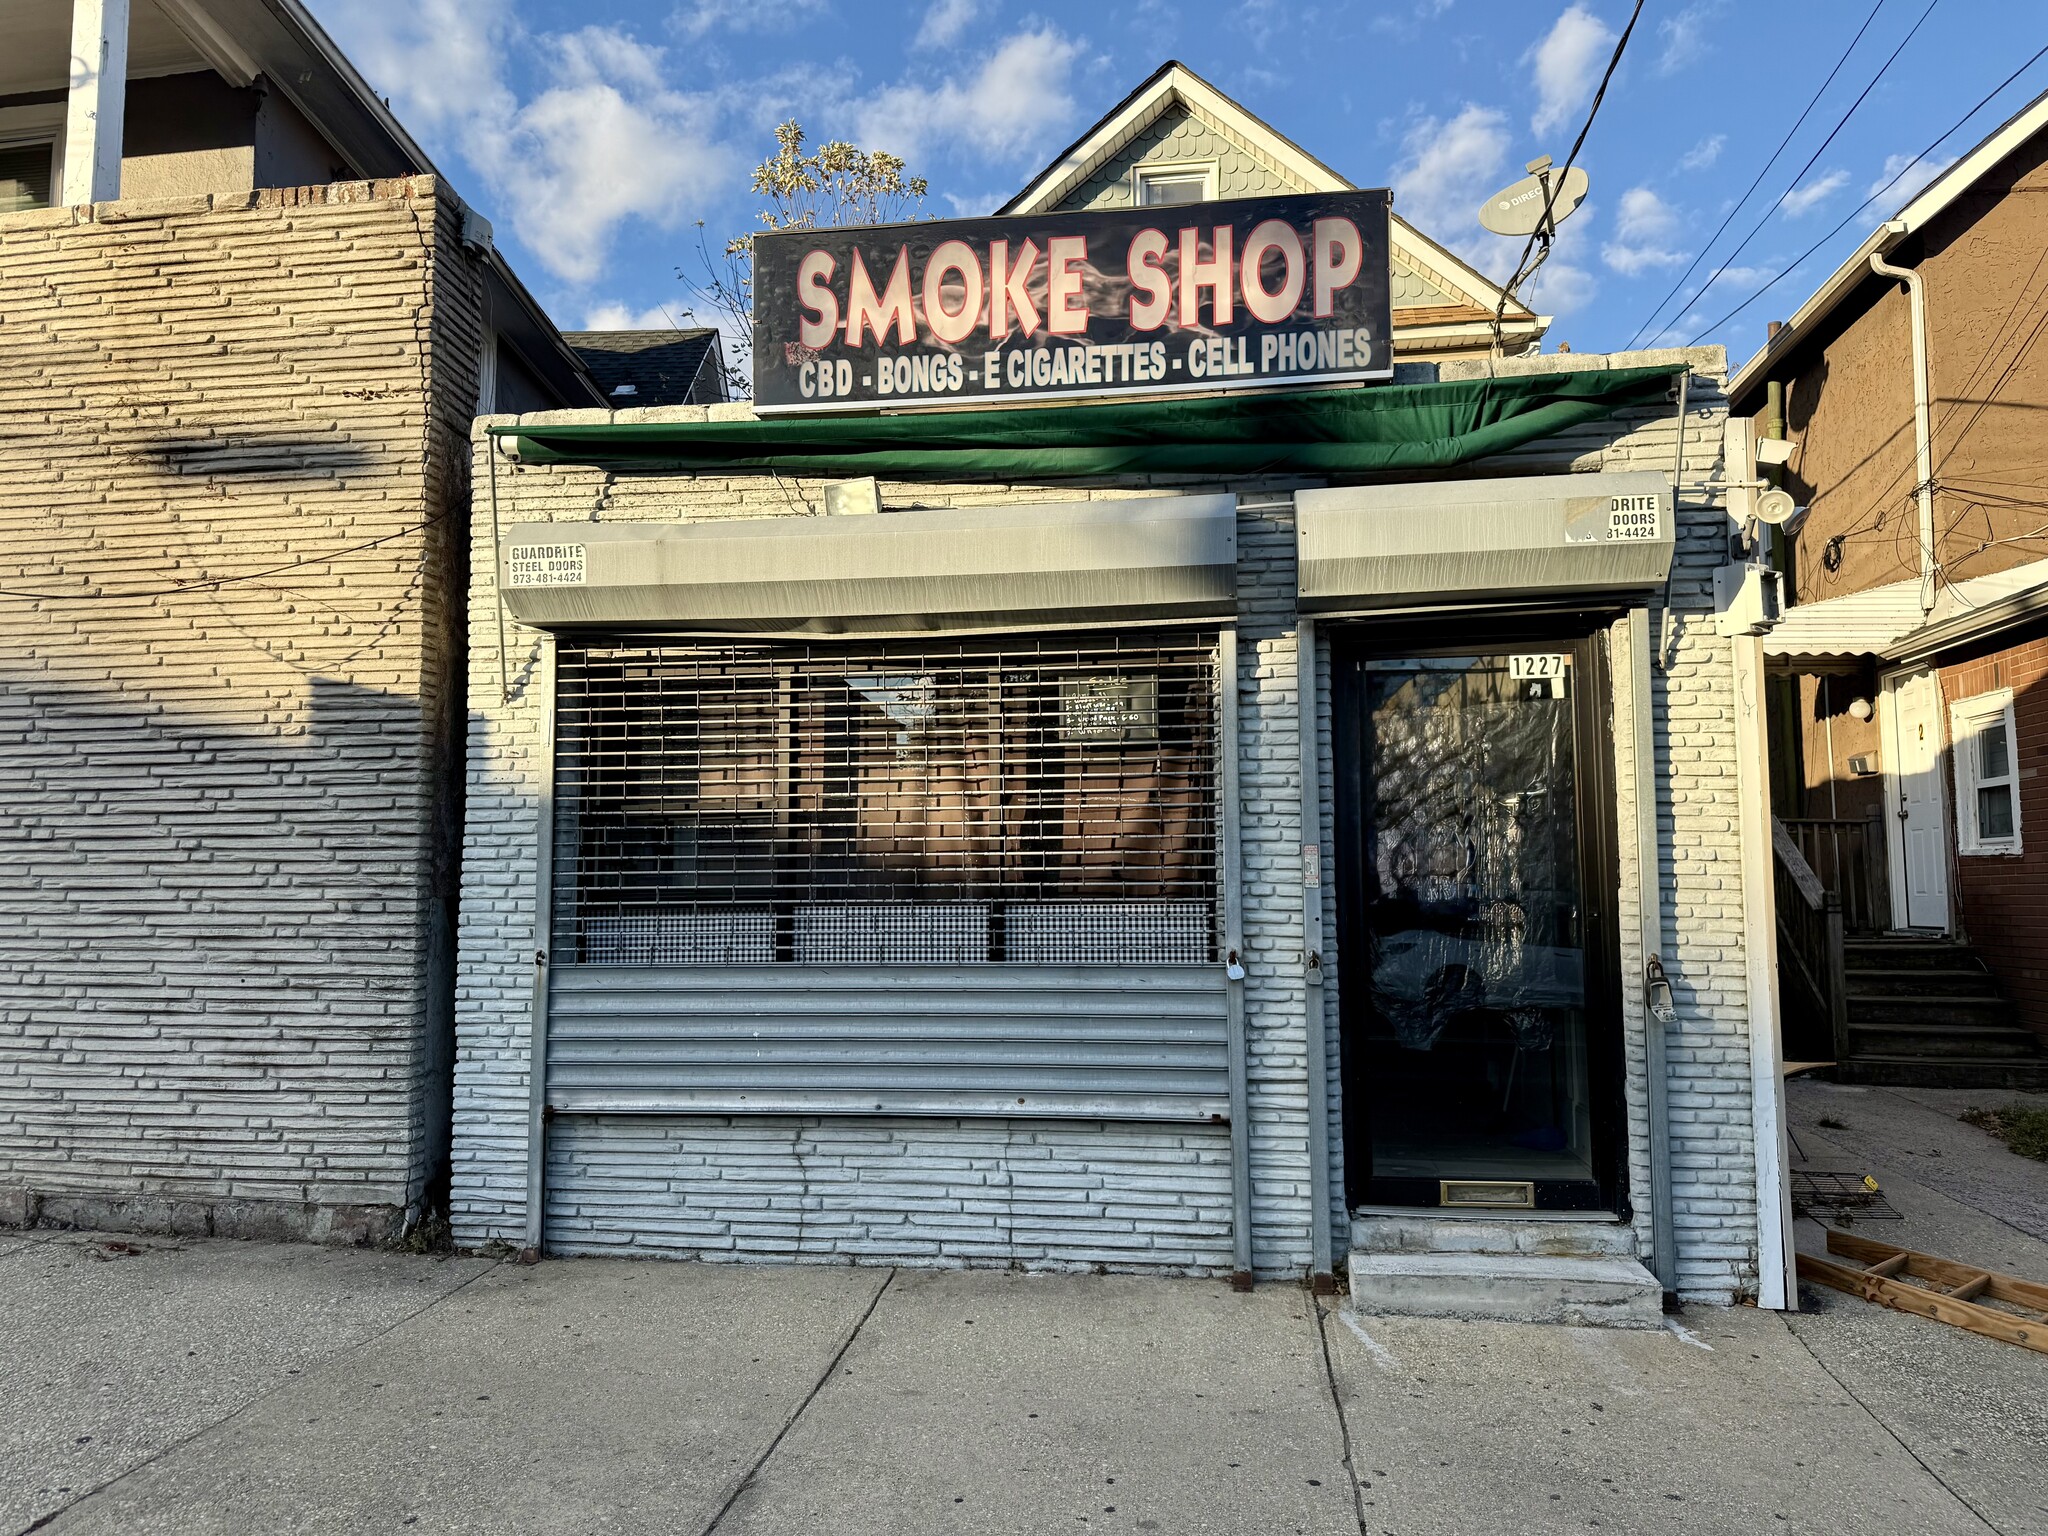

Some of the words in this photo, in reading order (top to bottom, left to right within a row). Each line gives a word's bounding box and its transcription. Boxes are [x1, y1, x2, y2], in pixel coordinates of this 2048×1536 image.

[797, 236, 1090, 350] SMOKE
[1127, 217, 1363, 332] SHOP
[799, 359, 853, 398] CBD
[877, 353, 964, 395] BONGS
[984, 350, 1001, 389] E
[1007, 340, 1167, 389] CIGARETTES
[1188, 336, 1255, 379] CELL
[1261, 328, 1372, 373] PHONES
[1611, 497, 1655, 512] DRITE
[1613, 513, 1656, 526] DOORS
[512, 545, 583, 560] GUARDRITE
[512, 561, 544, 573] STEEL
[548, 560, 583, 572] DOORS
[513, 572, 582, 584] 973-481-4424
[1513, 656, 1561, 676] 1227
[1919, 724, 1924, 741] 2
